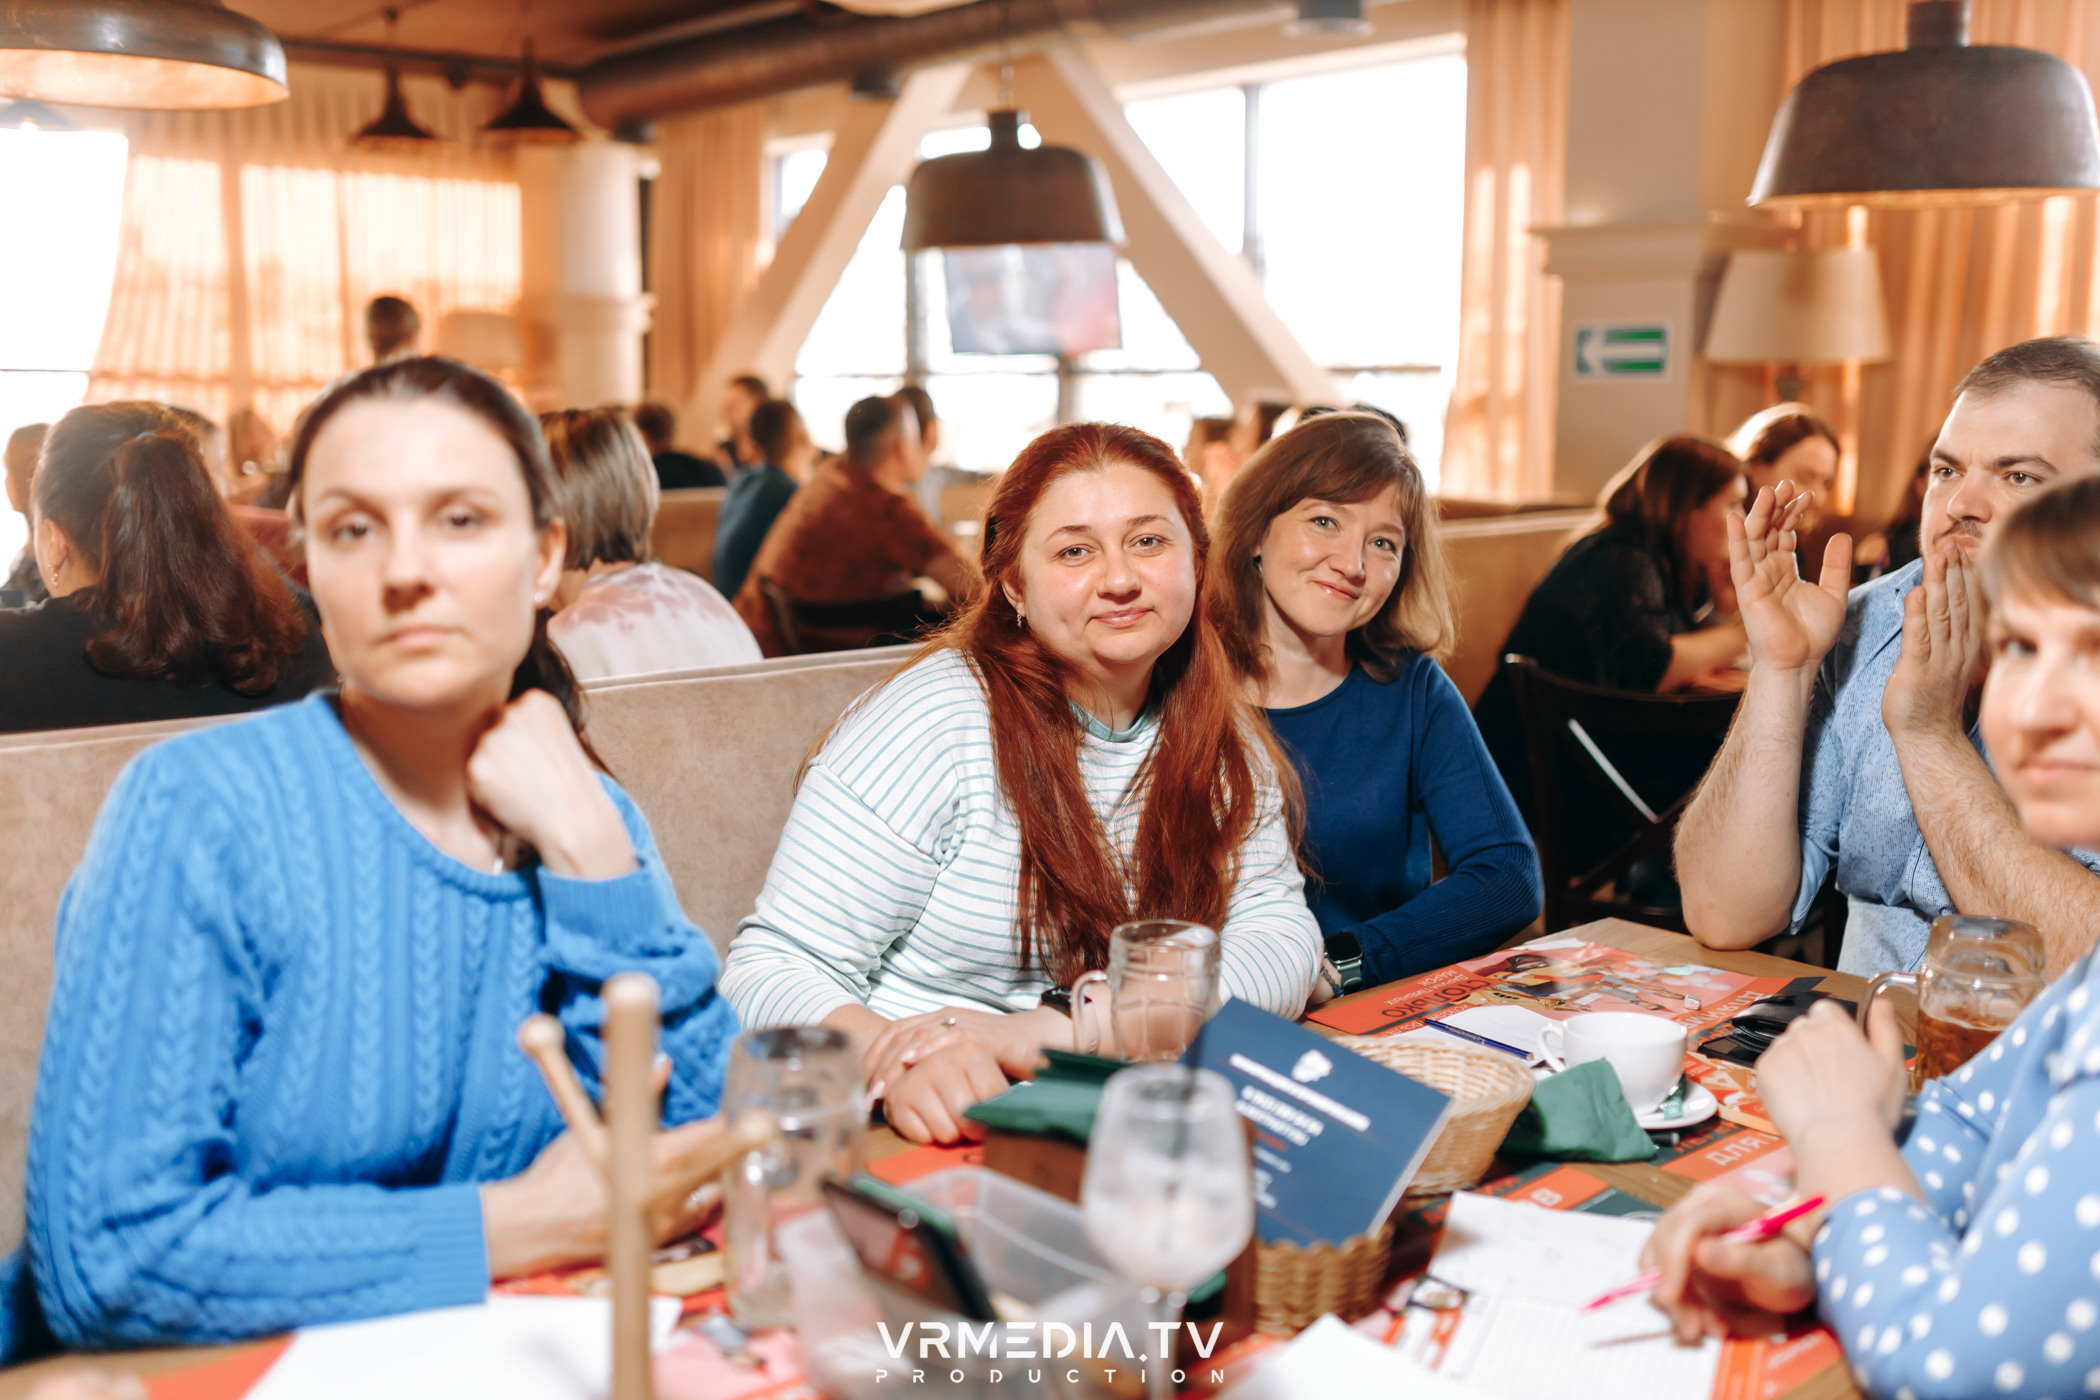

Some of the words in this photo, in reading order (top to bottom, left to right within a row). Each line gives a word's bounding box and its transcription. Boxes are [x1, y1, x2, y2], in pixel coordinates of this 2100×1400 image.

[1417, 969, 1459, 987] МАРОК
[1381, 980, 1491, 1018] СТОЛЬКО
[1704, 1135, 1770, 1167] ДЛЯ
